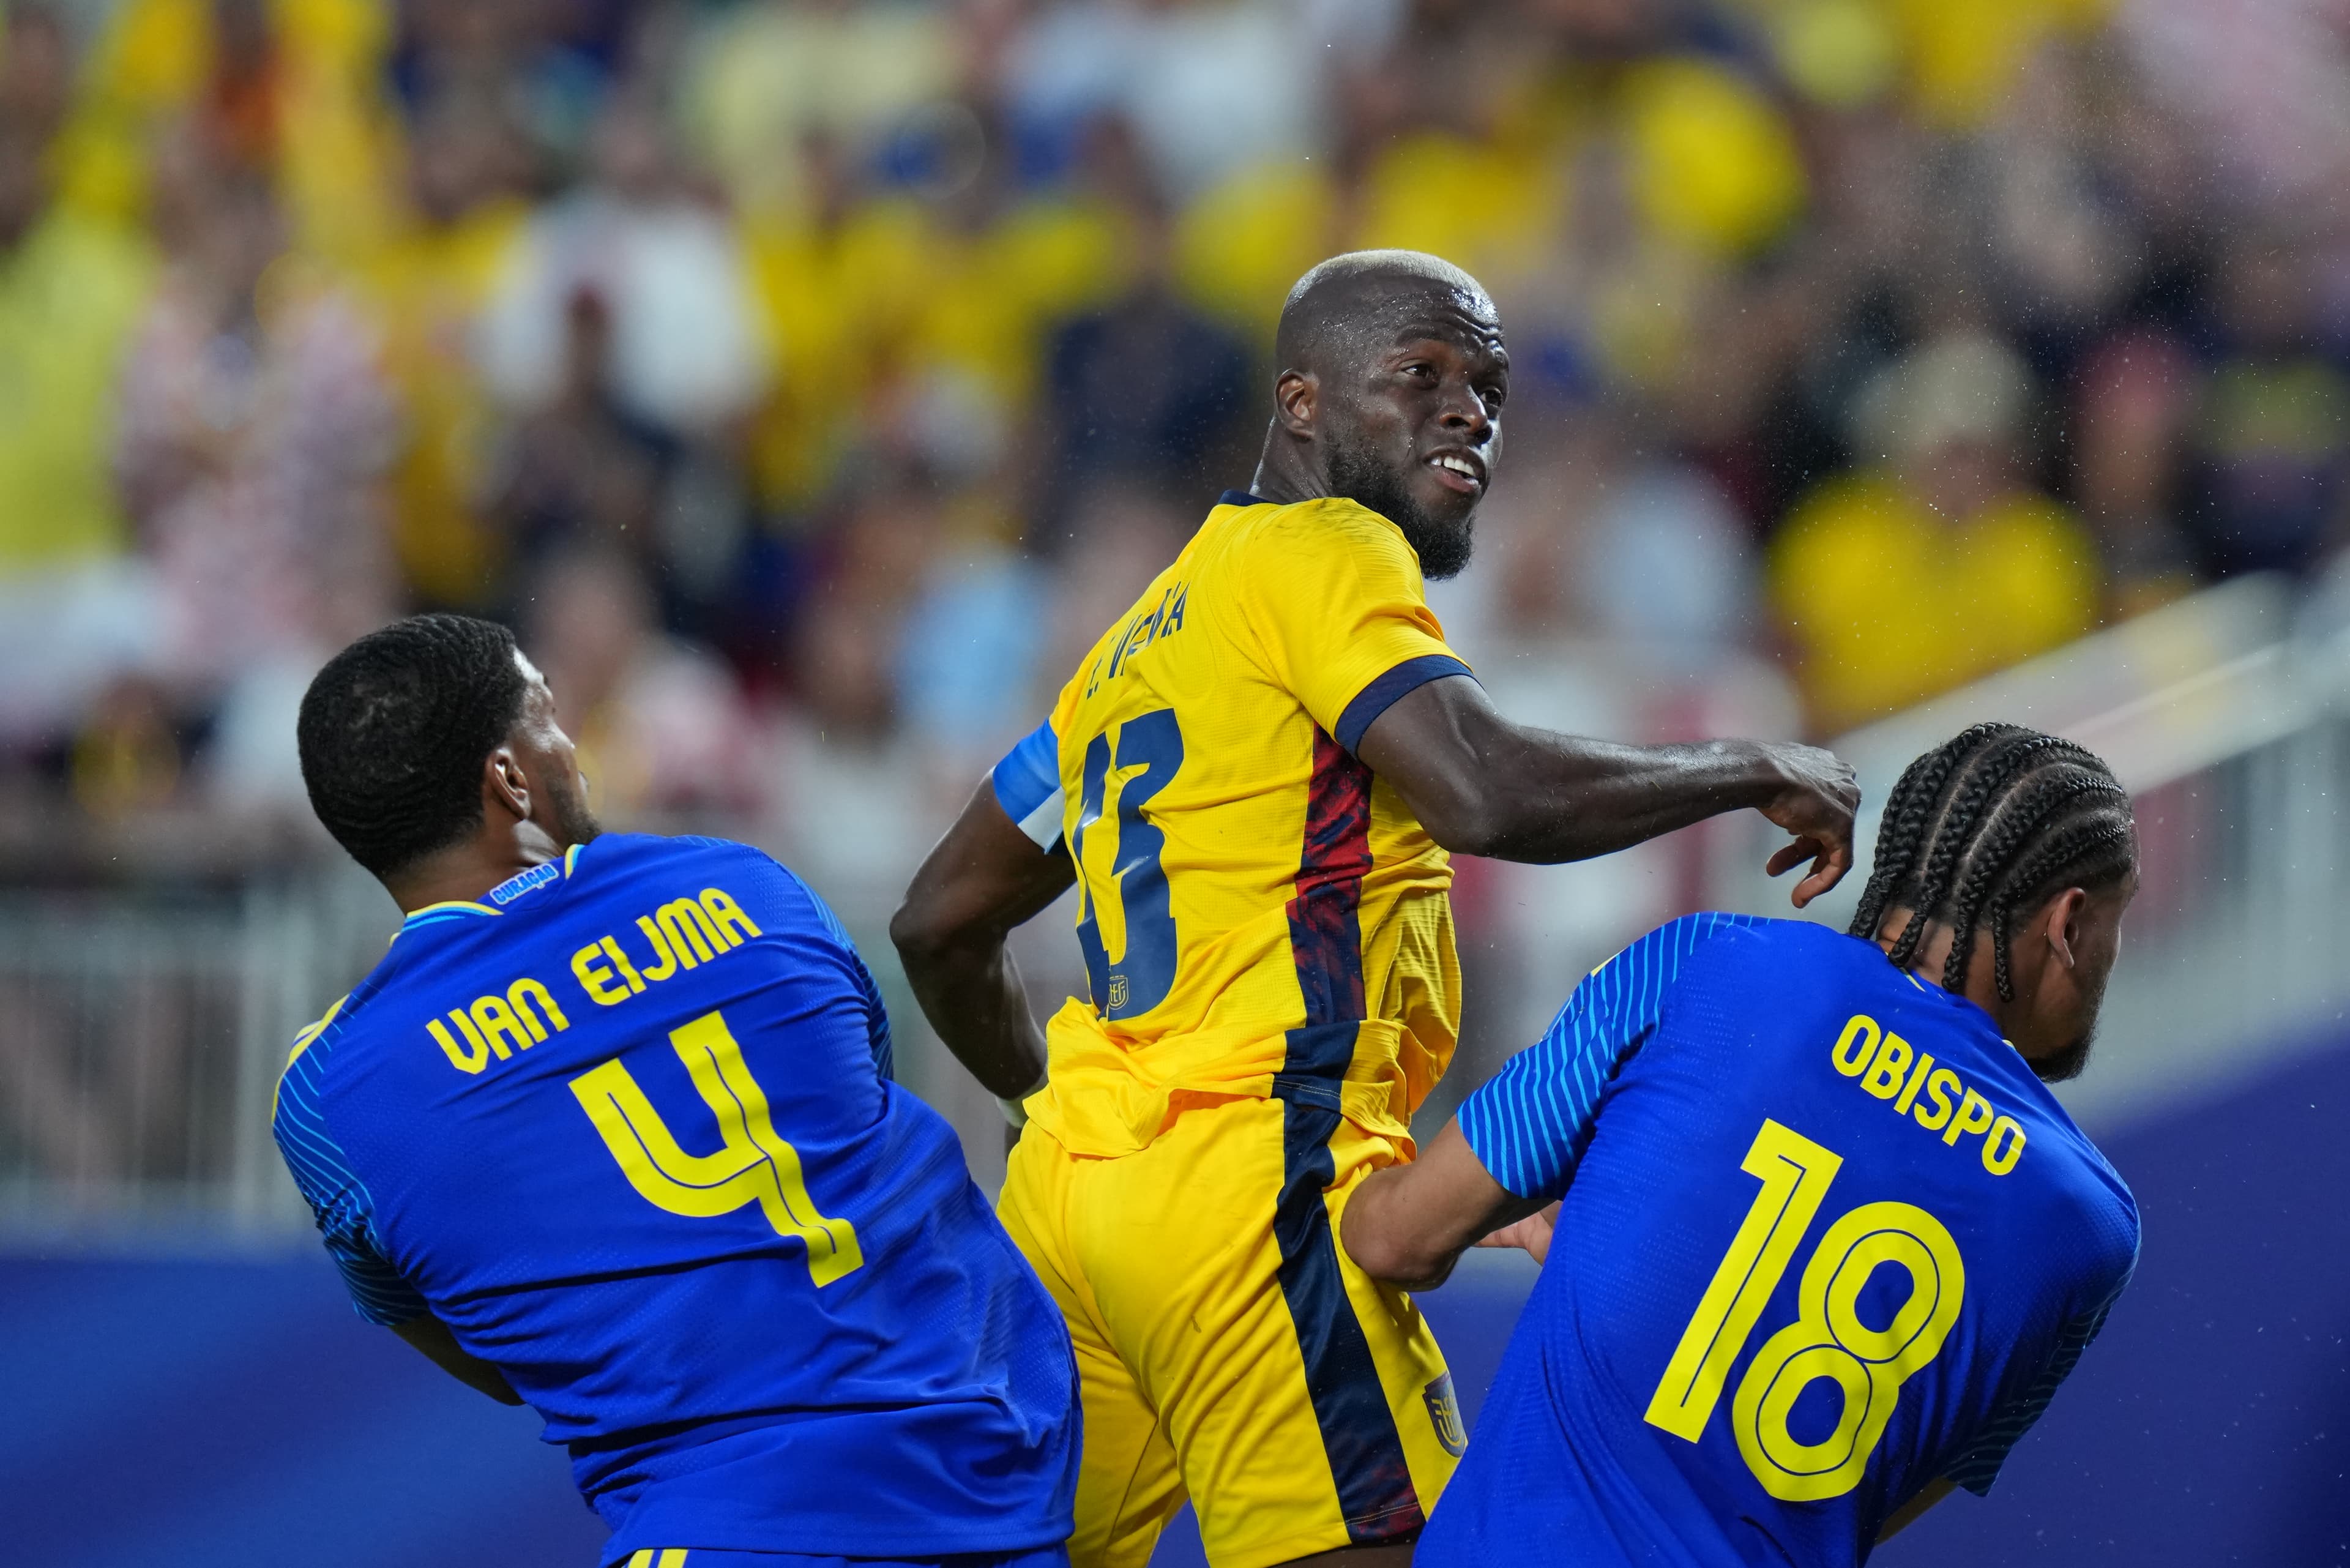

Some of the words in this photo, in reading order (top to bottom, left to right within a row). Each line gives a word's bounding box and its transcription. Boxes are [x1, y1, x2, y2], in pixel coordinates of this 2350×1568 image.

[490, 864, 558, 905] CURAÇAO
[425, 977, 570, 1075] VAN
[570, 887, 763, 1006] EIJMA
[567, 1010, 864, 1288] 4
[1831, 1014, 2027, 1176] OBISPO
[1643, 1118, 1965, 1502] 18
